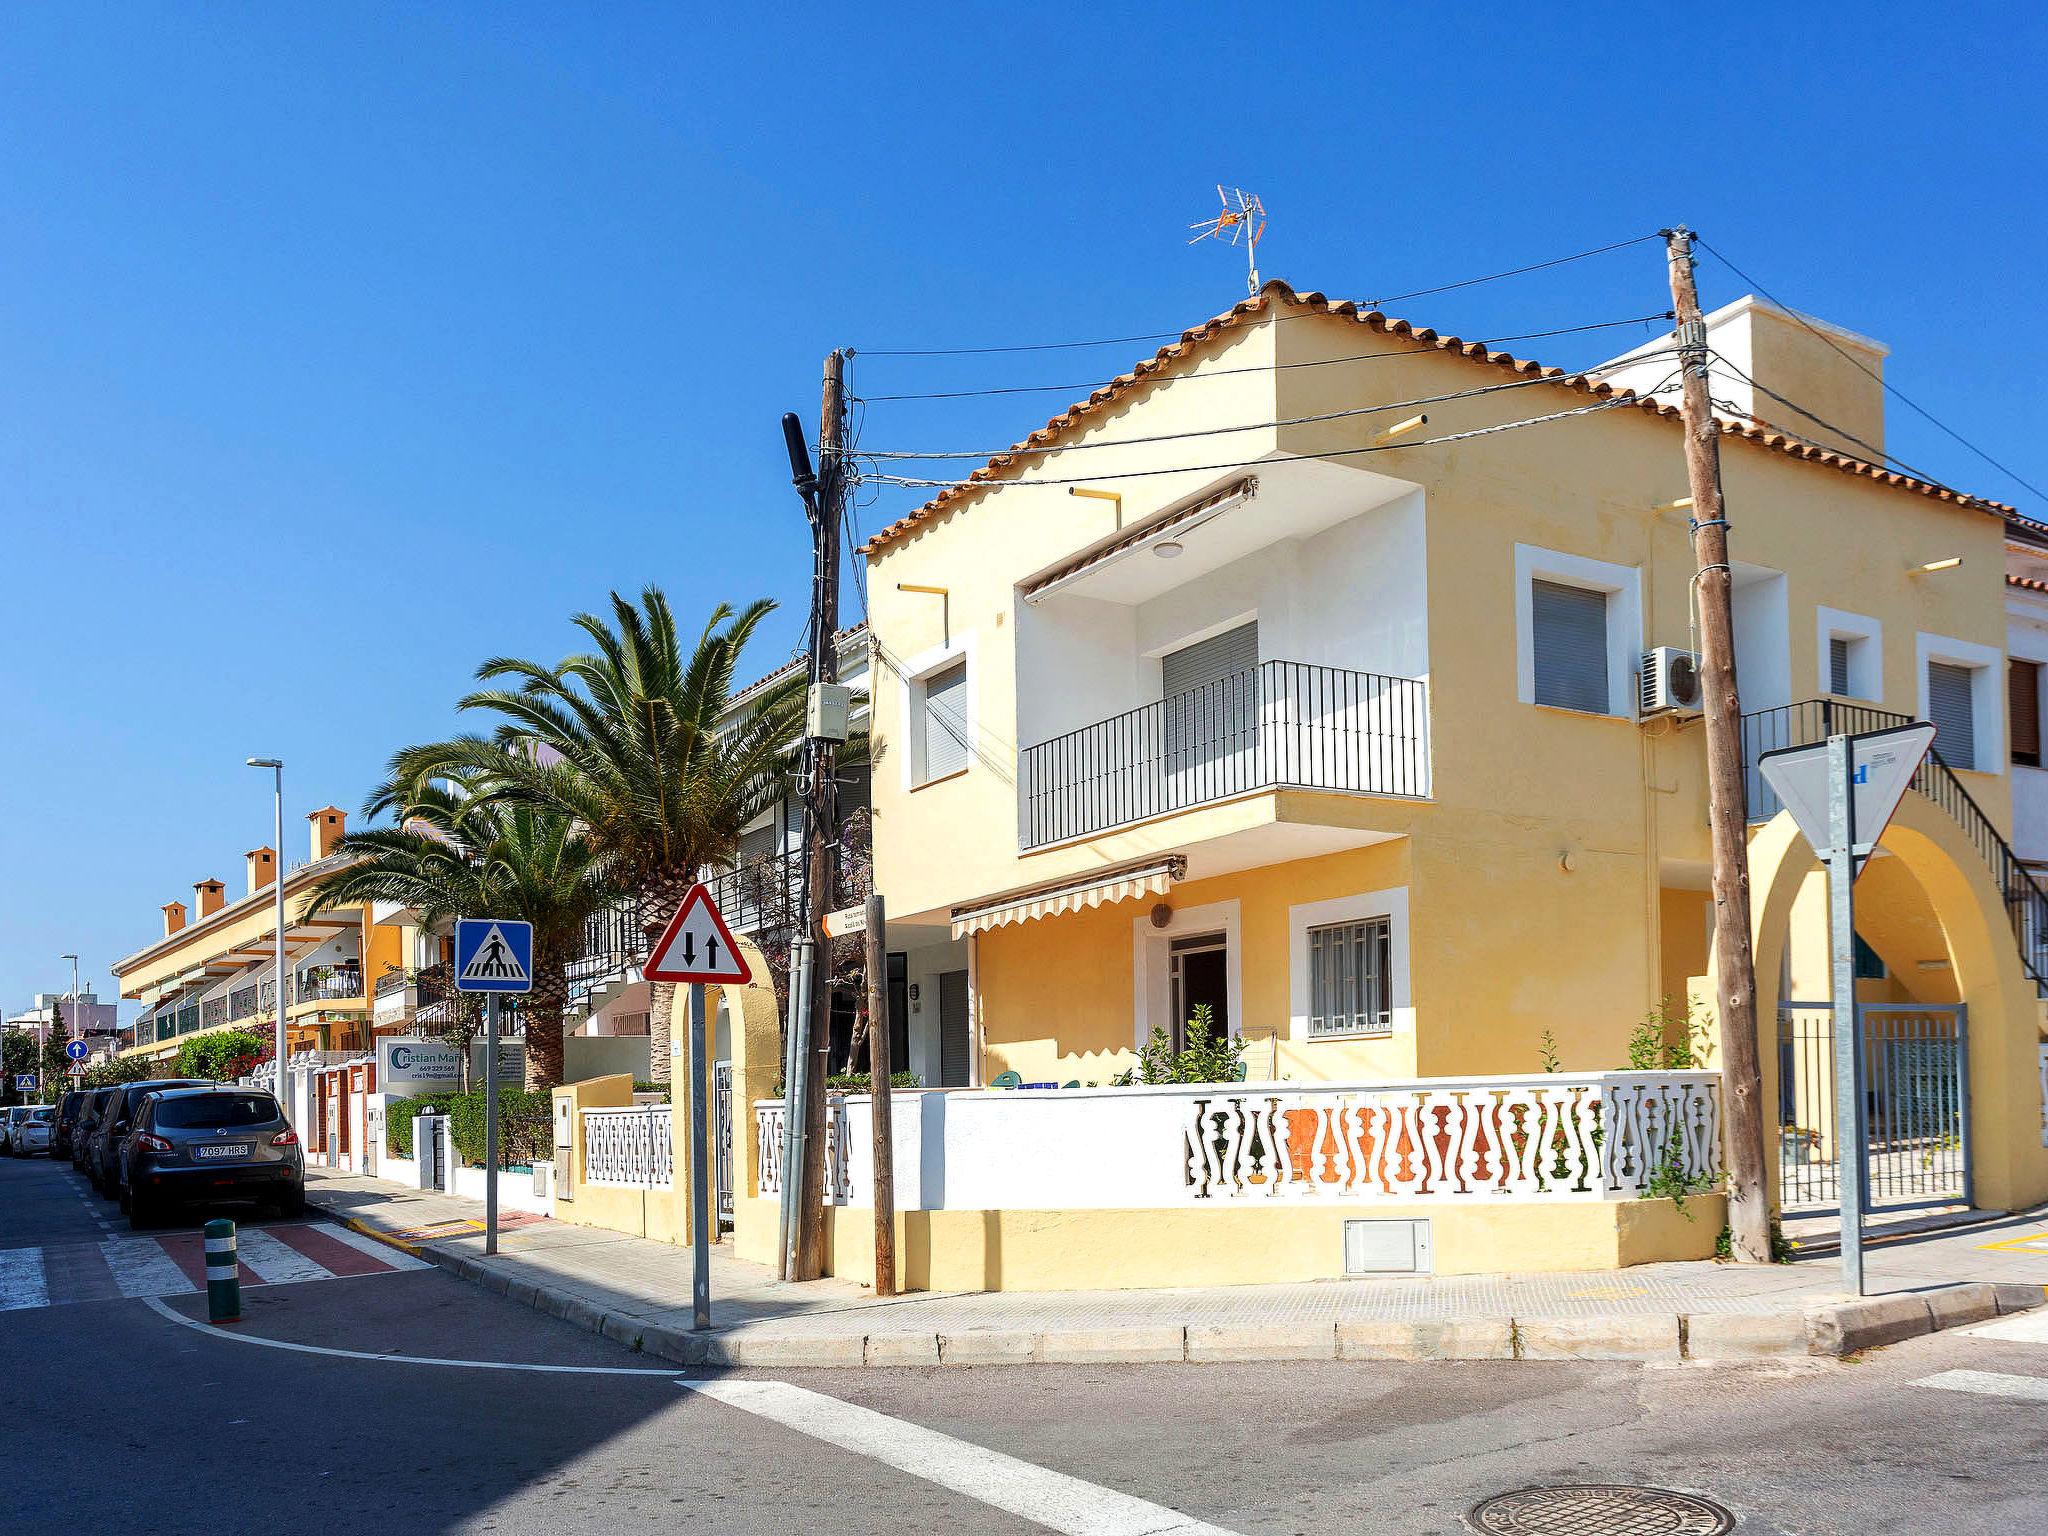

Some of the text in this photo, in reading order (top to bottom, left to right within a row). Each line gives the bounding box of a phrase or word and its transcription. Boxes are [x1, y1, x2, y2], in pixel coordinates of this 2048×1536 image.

[391, 1046, 435, 1070] Cristian
[201, 1145, 247, 1156] 7097 HRS
